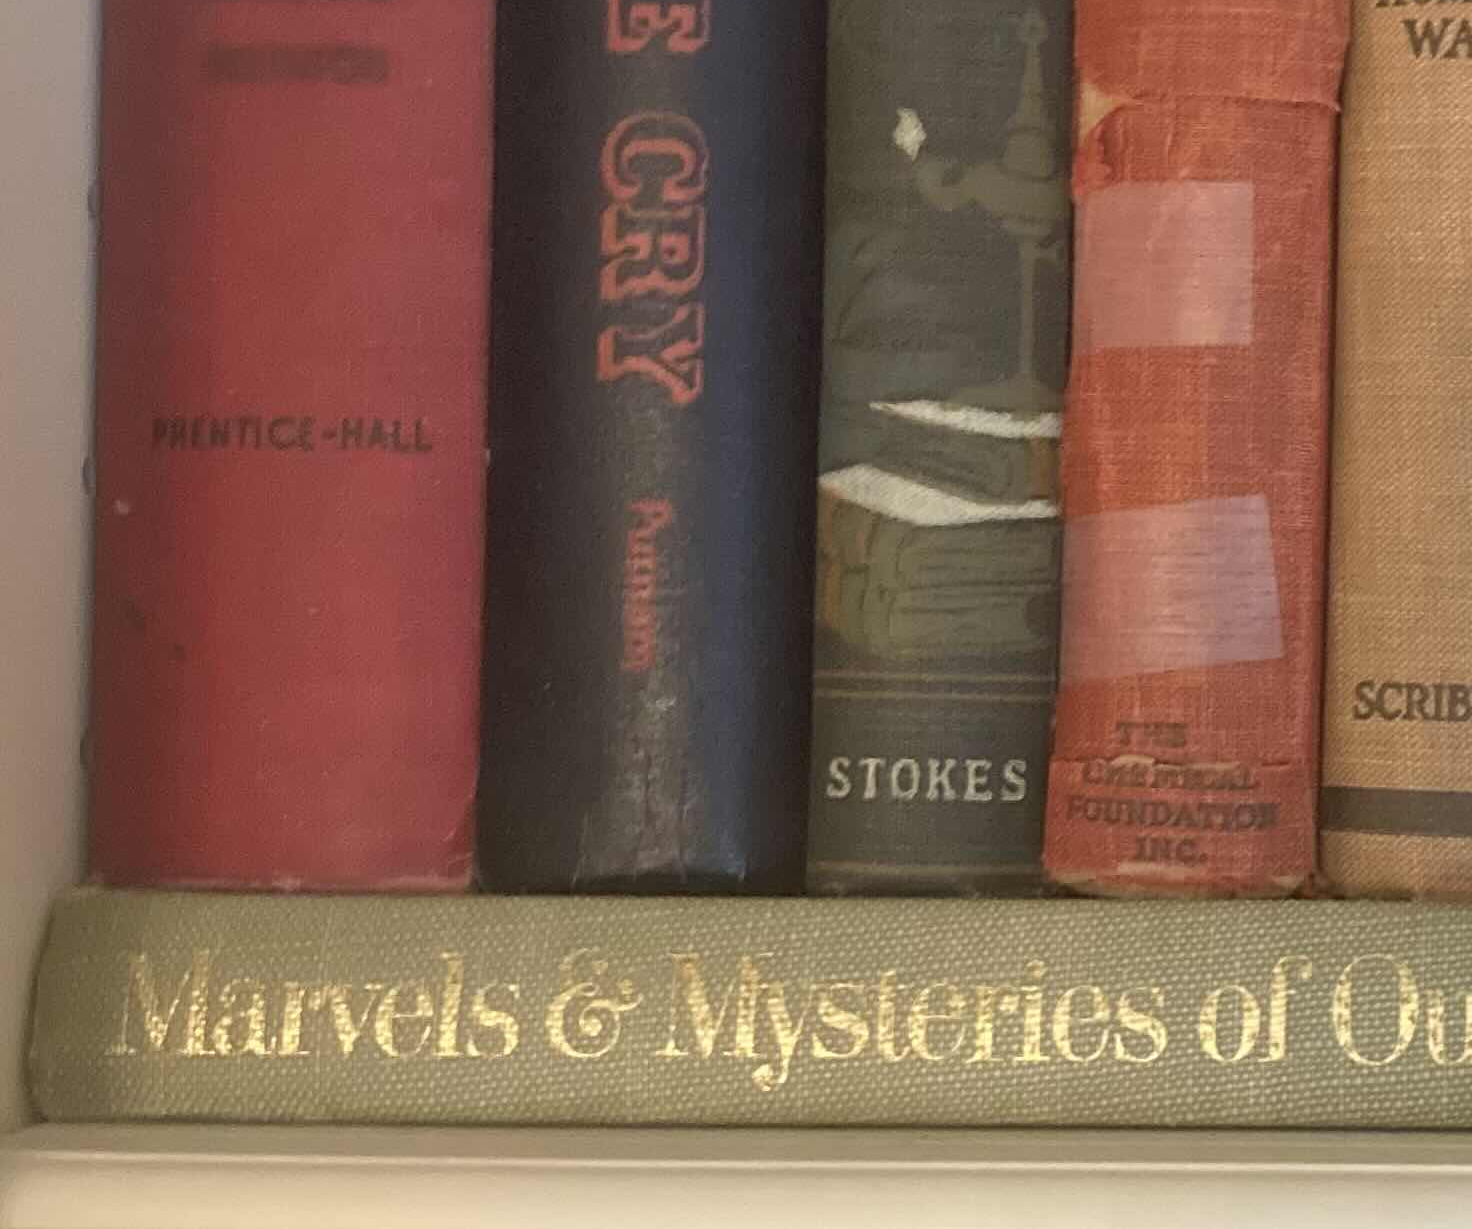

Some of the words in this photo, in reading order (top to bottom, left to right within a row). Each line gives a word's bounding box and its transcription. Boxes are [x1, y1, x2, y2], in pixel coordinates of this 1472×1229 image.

[598, 110, 709, 406] CRY
[151, 416, 433, 453] PRENTICE-HALL
[826, 756, 1028, 802] STOKES
[1134, 835, 1209, 864] INC.
[104, 947, 521, 1060] Marvels
[543, 947, 645, 1060] &
[653, 950, 1170, 1094] Mysteries
[1198, 952, 1314, 1064] of
